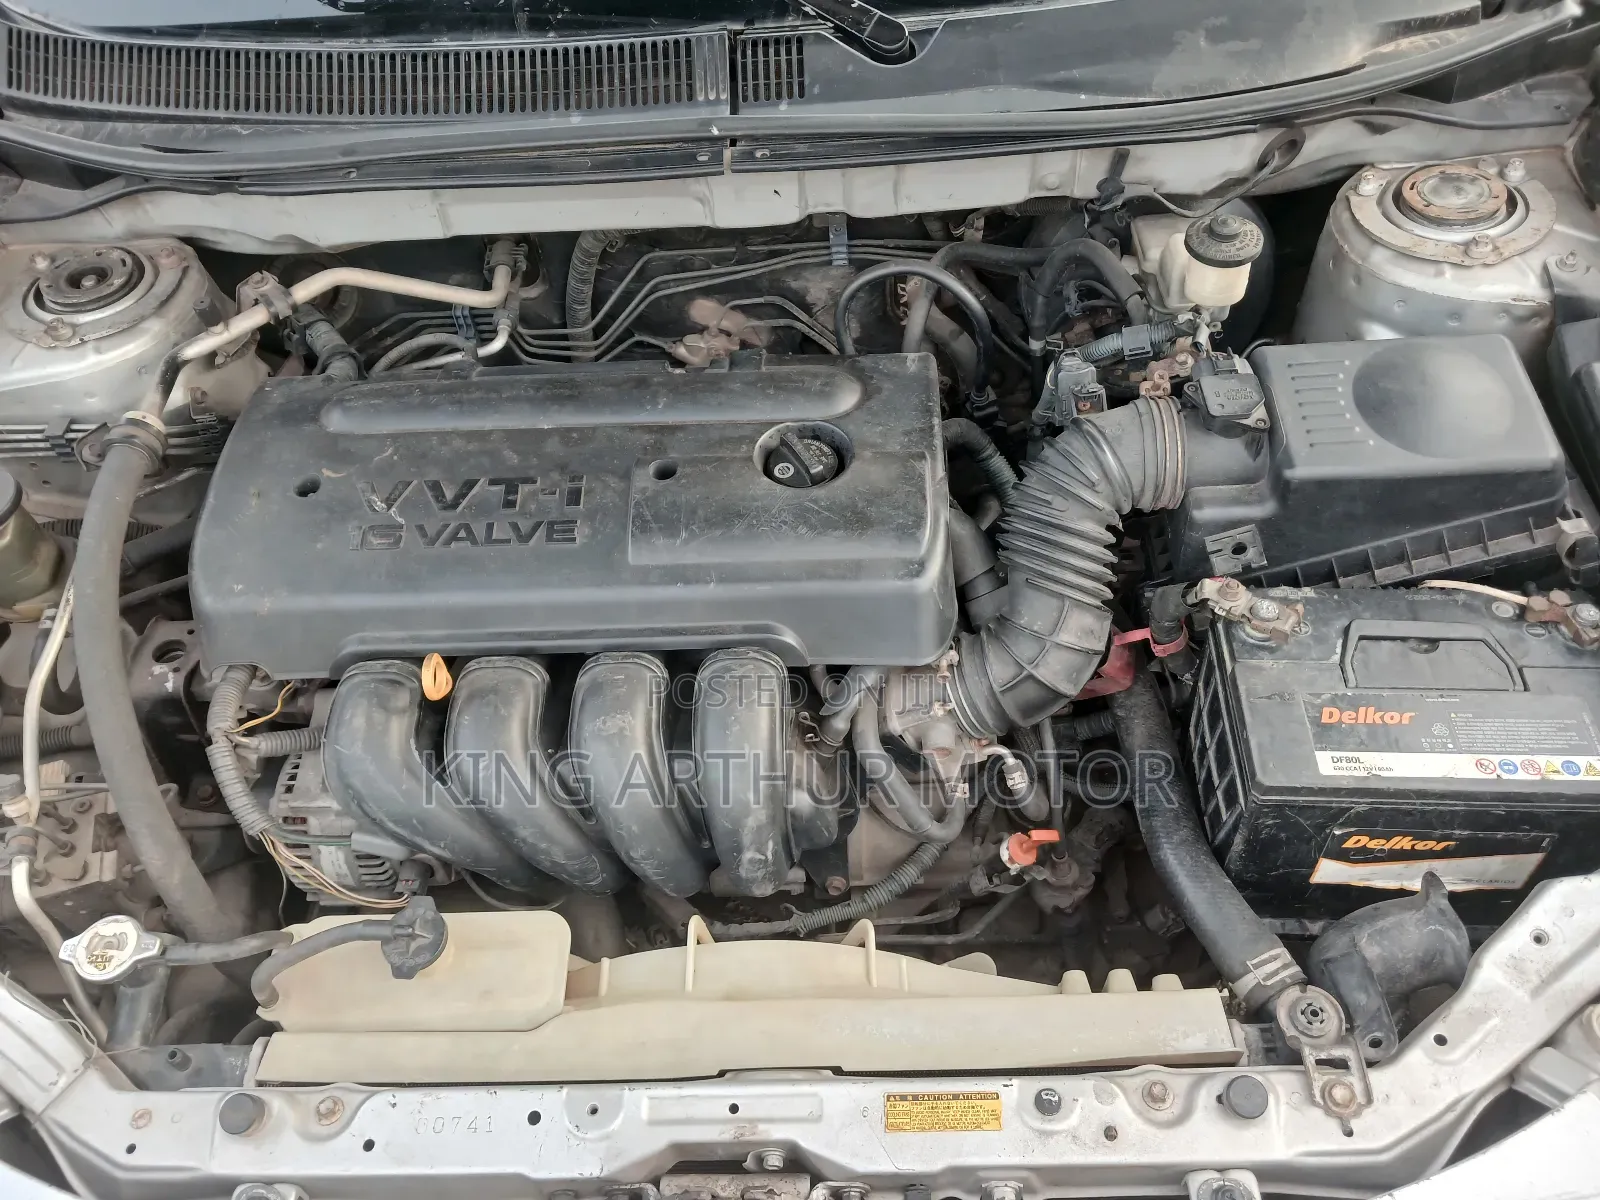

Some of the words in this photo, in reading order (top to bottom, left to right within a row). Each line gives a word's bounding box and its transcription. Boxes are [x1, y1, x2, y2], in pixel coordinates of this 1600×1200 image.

[350, 523, 407, 551] 16
[413, 519, 581, 549] VALVE
[1321, 706, 1416, 724] Delkor
[1331, 756, 1364, 764] DF80L
[1341, 835, 1457, 850] Delkor
